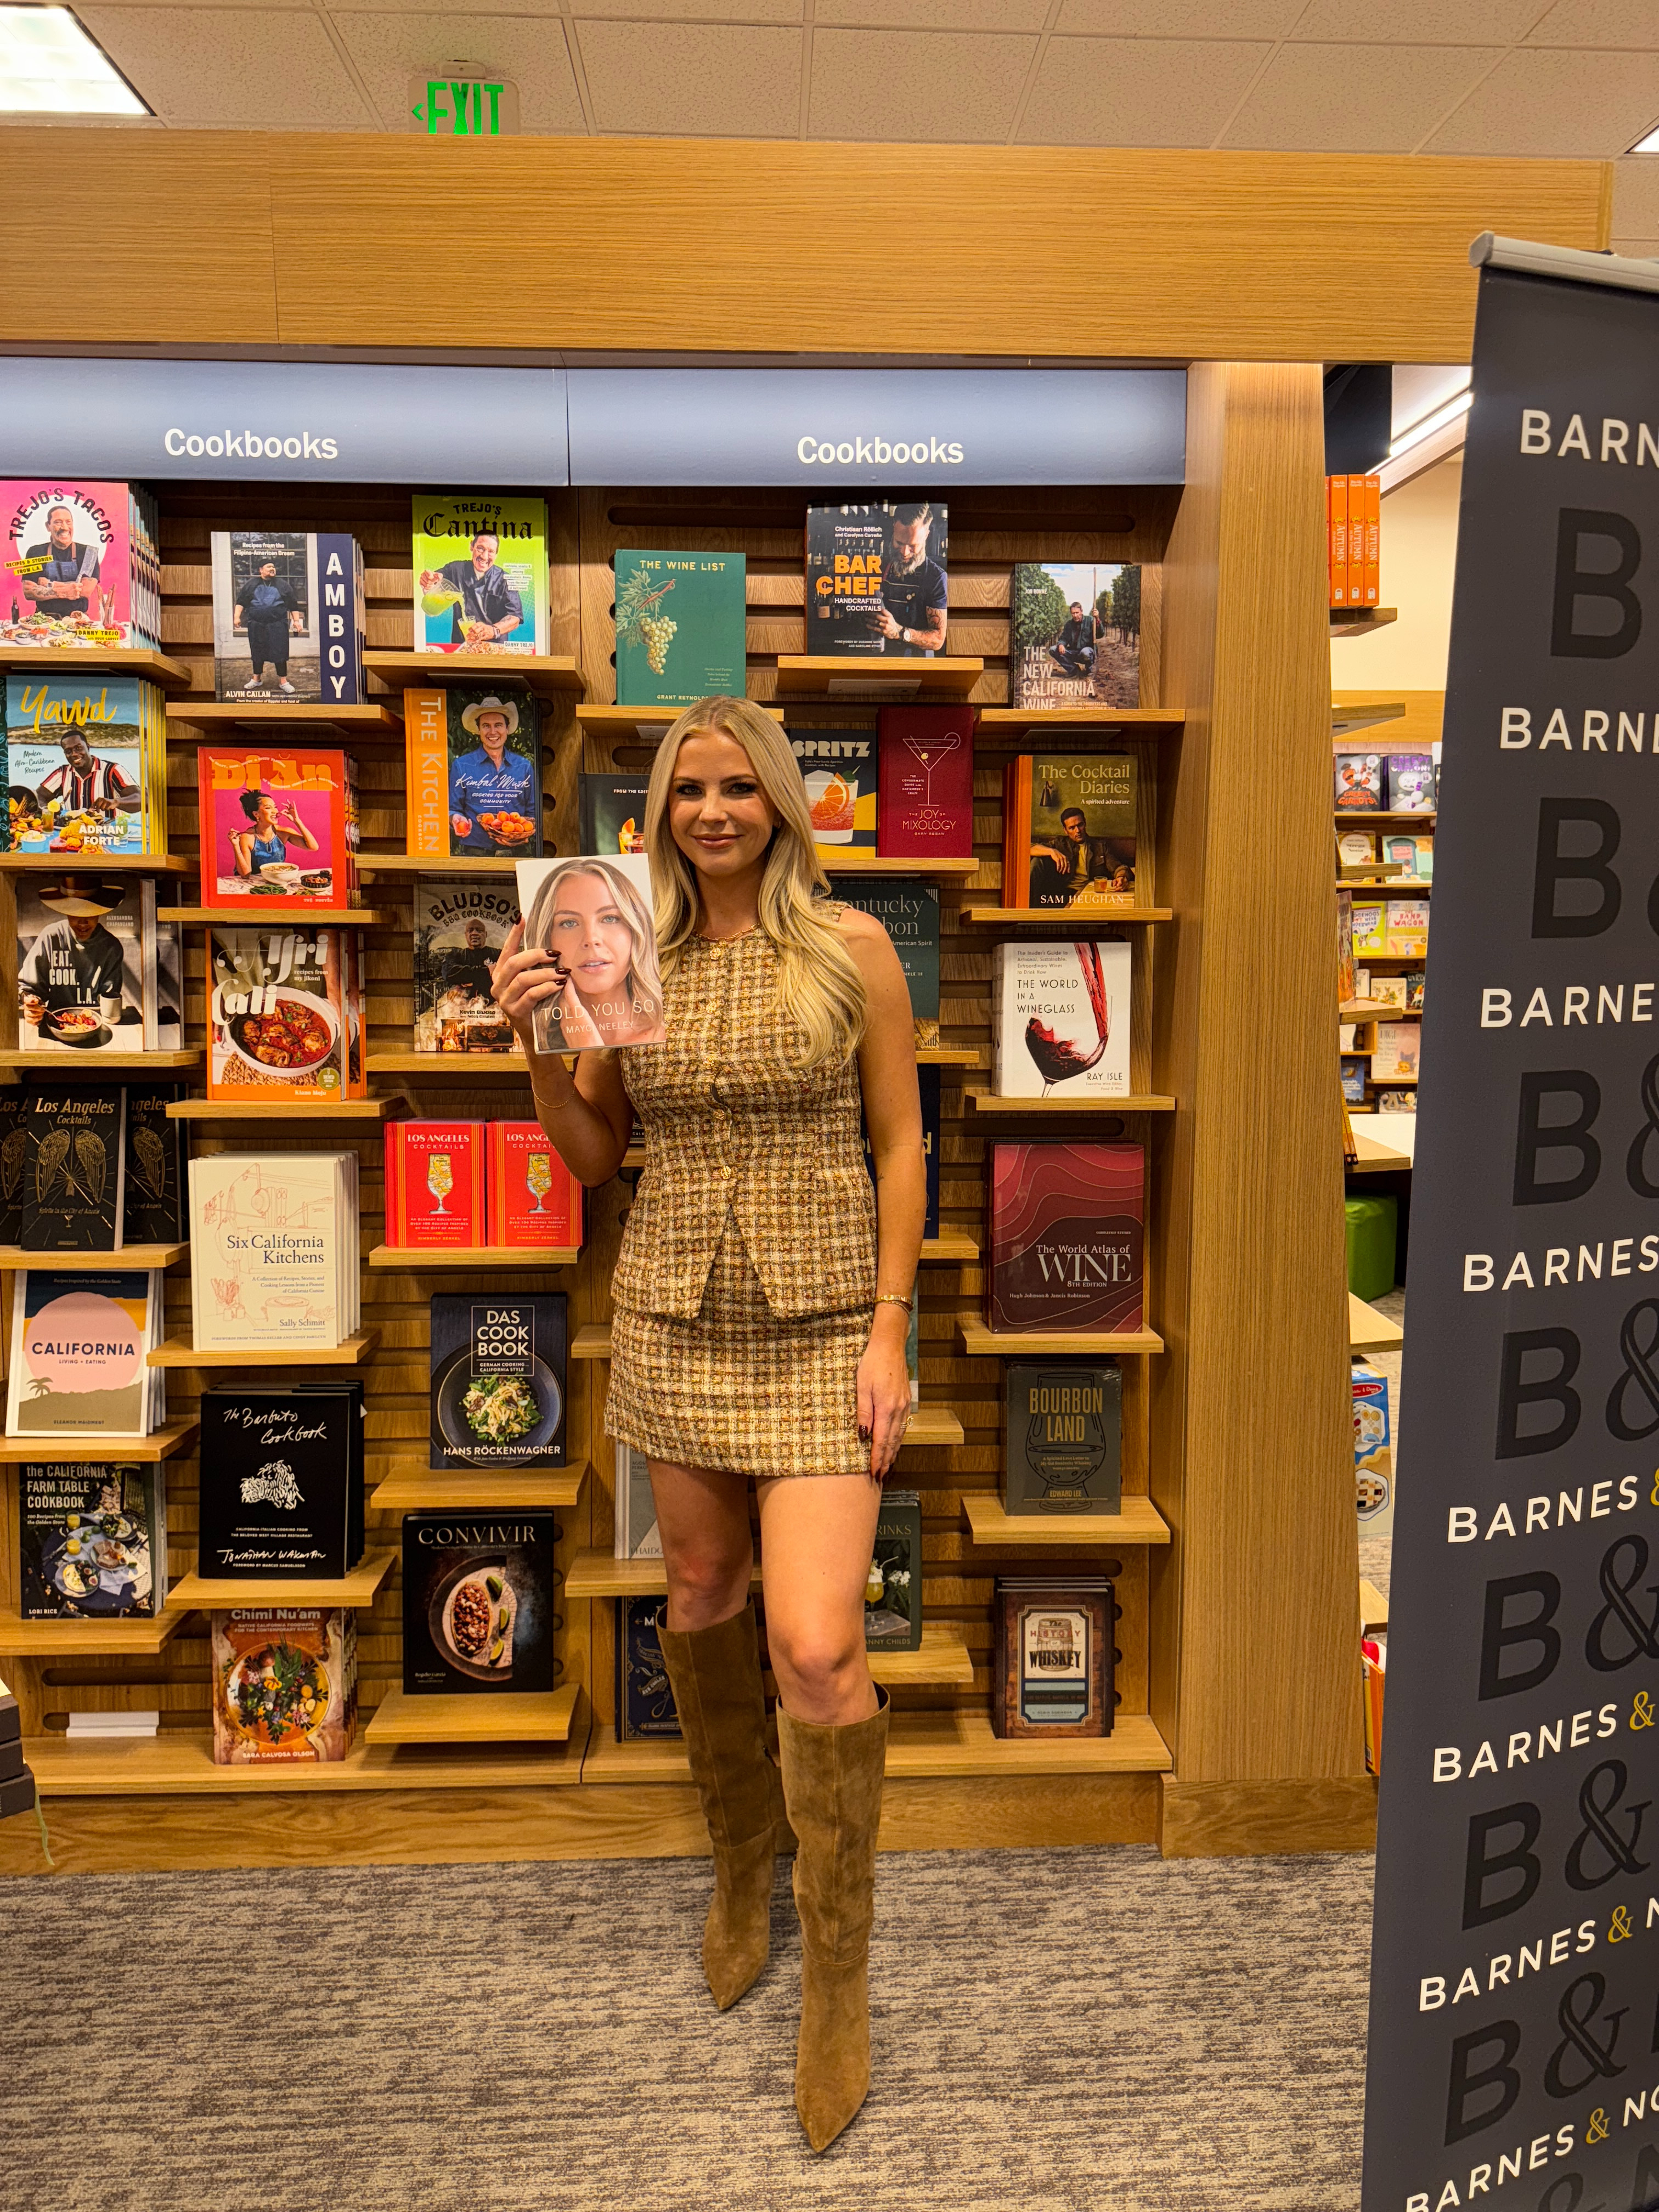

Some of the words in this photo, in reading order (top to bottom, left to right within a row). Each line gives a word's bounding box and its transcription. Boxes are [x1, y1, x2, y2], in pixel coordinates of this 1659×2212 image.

[427, 82, 504, 136] EXIT
[165, 428, 338, 459] Cookbooks
[1520, 409, 1659, 469] BARN
[797, 436, 964, 464] Cookbooks
[9, 488, 64, 540] TREJO'S
[74, 490, 114, 543] TACOS
[453, 503, 502, 515] TREJO'S
[423, 512, 534, 539] Cantina
[1337, 524, 1345, 561] AUTUMN
[1353, 524, 1362, 560] AUTUMN
[1370, 524, 1378, 561] AUTUMN
[640, 560, 661, 569] THE
[667, 561, 696, 571] WINE
[701, 563, 726, 571] LIST
[834, 555, 882, 574] BAR
[816, 576, 882, 595] CHEF
[1550, 507, 1642, 659] B
[325, 552, 346, 698] AMBOY
[1024, 646, 1046, 661] THE
[1023, 664, 1053, 678] NEW
[1023, 681, 1095, 696] CALIFORNIA
[420, 697, 442, 741] THE
[792, 740, 870, 757] SPRITZ
[1039, 765, 1066, 778] The
[1071, 764, 1130, 778] Cocktail
[455, 773, 494, 788] Kimbal
[496, 774, 531, 789] Musk
[1080, 780, 1130, 794] Diaries
[421, 753, 443, 850] KITCHEN
[919, 809, 939, 820] JOY
[78, 826, 124, 834] ADRIAN
[902, 820, 956, 830] MIXOLOGY
[84, 837, 120, 845] FORTE
[1040, 895, 1064, 904] SAM
[1069, 895, 1124, 904] HEUGHAN
[443, 912, 460, 927] BBQ
[53, 950, 72, 967] EAT.
[49, 969, 80, 985] COOK.
[1017, 980, 1035, 988] THE
[1040, 980, 1078, 988] WORLD
[77, 988, 95, 1004] L.A.
[541, 1006, 584, 1021] TOLD
[591, 1002, 625, 1017] YOU
[633, 999, 654, 1014] SO
[1017, 1005, 1075, 1013] WINEGLASS
[1481, 983, 1654, 1028] BARNE
[566, 1023, 594, 1034] MAYCI
[599, 1021, 634, 1031] NEELEY
[35, 1098, 57, 1113] Los
[60, 1098, 115, 1115] Angeles
[57, 1115, 92, 1124] Cocktails
[228, 1235, 249, 1249] Six
[252, 1235, 324, 1248] California
[1036, 1245, 1054, 1254] The
[1058, 1245, 1087, 1254] World
[1091, 1245, 1116, 1254] Atlas
[1120, 1245, 1130, 1254] of
[263, 1251, 324, 1264] Kitchens
[1463, 1235, 1659, 1292] BARNES
[1037, 1254, 1131, 1282] WINE
[280, 1319, 296, 1328] Sally
[487, 1311, 520, 1324] DAS
[477, 1326, 529, 1340] COOK
[32, 1342, 135, 1356] CALIFORNIA
[478, 1342, 529, 1356] BOOK
[1030, 1388, 1103, 1413] BOURBON
[223, 1408, 239, 1423] The
[242, 1408, 298, 1428] Barbuto
[261, 1422, 327, 1444] Cookbook
[1047, 1415, 1085, 1441] LAND
[443, 1447, 471, 1455] HANS
[474, 1444, 561, 1455] RÖCKENWAGNER
[27, 1465, 43, 1477] the
[47, 1465, 106, 1478] CALIFORNIA
[27, 1481, 55, 1492] FARM
[59, 1481, 89, 1492] TABLE
[27, 1496, 84, 1508] COOKBOOK
[1447, 1475, 1638, 1543] BARNES
[419, 1526, 535, 1544] CONVIVIR
[876, 1525, 911, 1535] RINKS
[1029, 1650, 1081, 1668] WHISKEY
[1433, 1703, 1617, 1782] BARNES
[1629, 1691, 1655, 1730] &
[1420, 1920, 1596, 2011] BARNES
[1607, 1905, 1634, 1943] &
[1444, 1972, 1659, 2147] B&
[1406, 2124, 1575, 2212] BARNES
[1585, 2108, 1611, 2144] &
